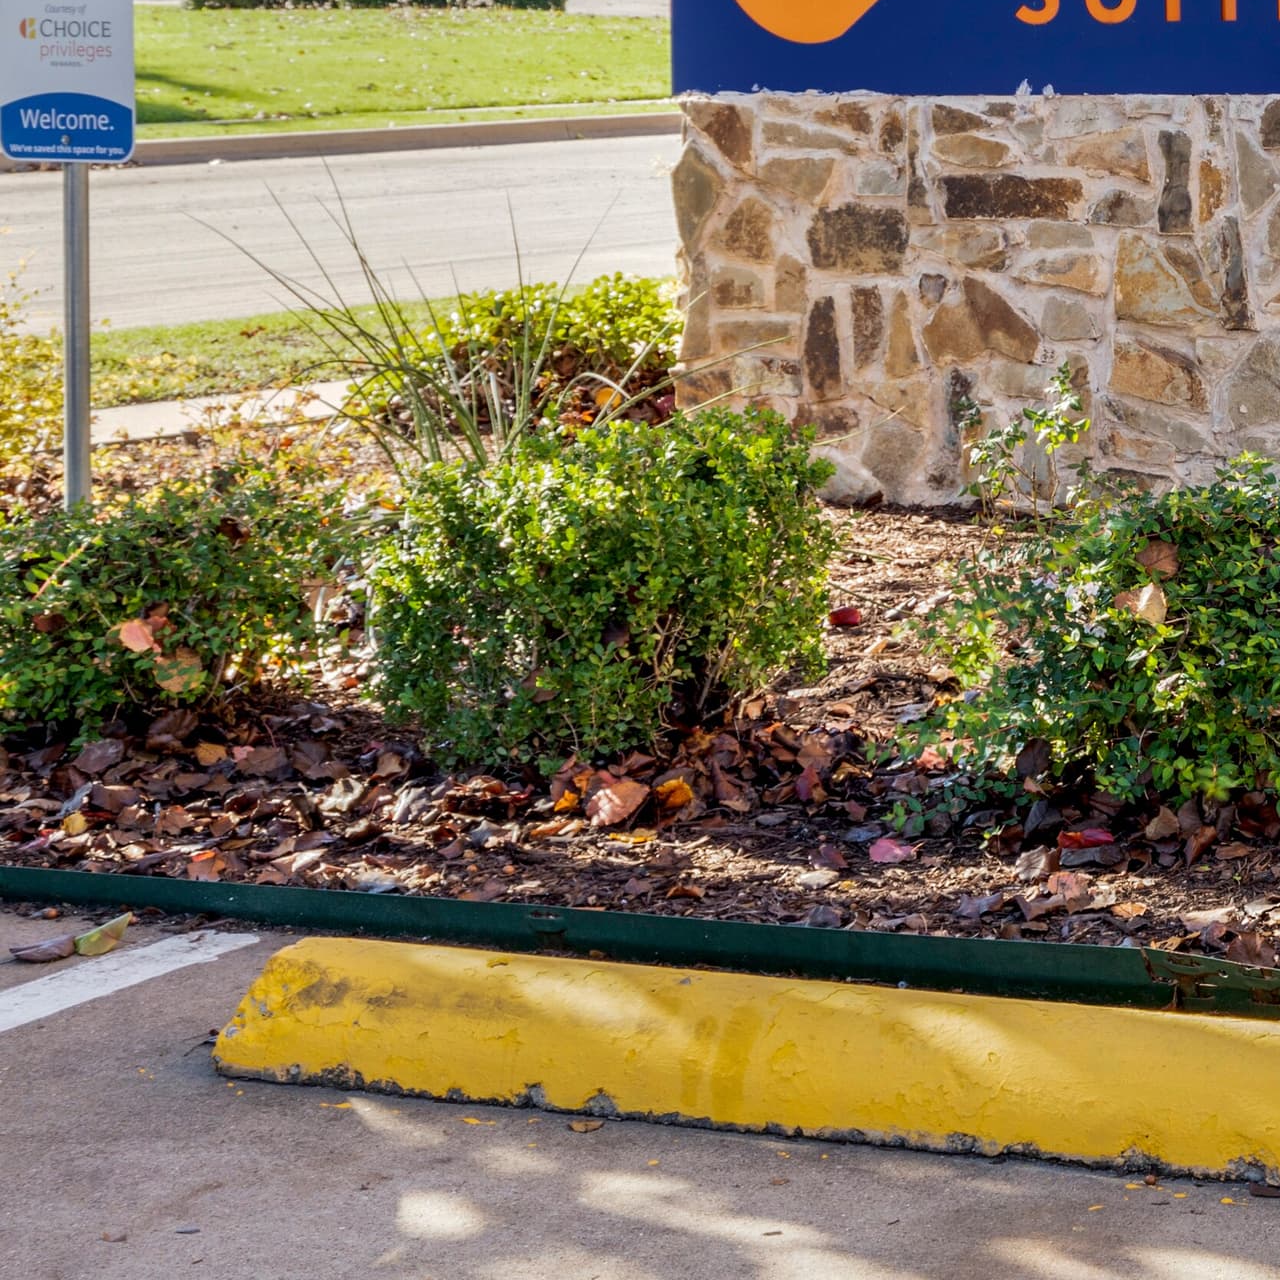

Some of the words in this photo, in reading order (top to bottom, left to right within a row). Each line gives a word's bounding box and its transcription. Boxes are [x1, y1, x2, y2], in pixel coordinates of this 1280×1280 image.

[39, 18, 112, 38] CHOICE
[40, 41, 113, 63] privileges
[20, 108, 115, 131] Welcome.
